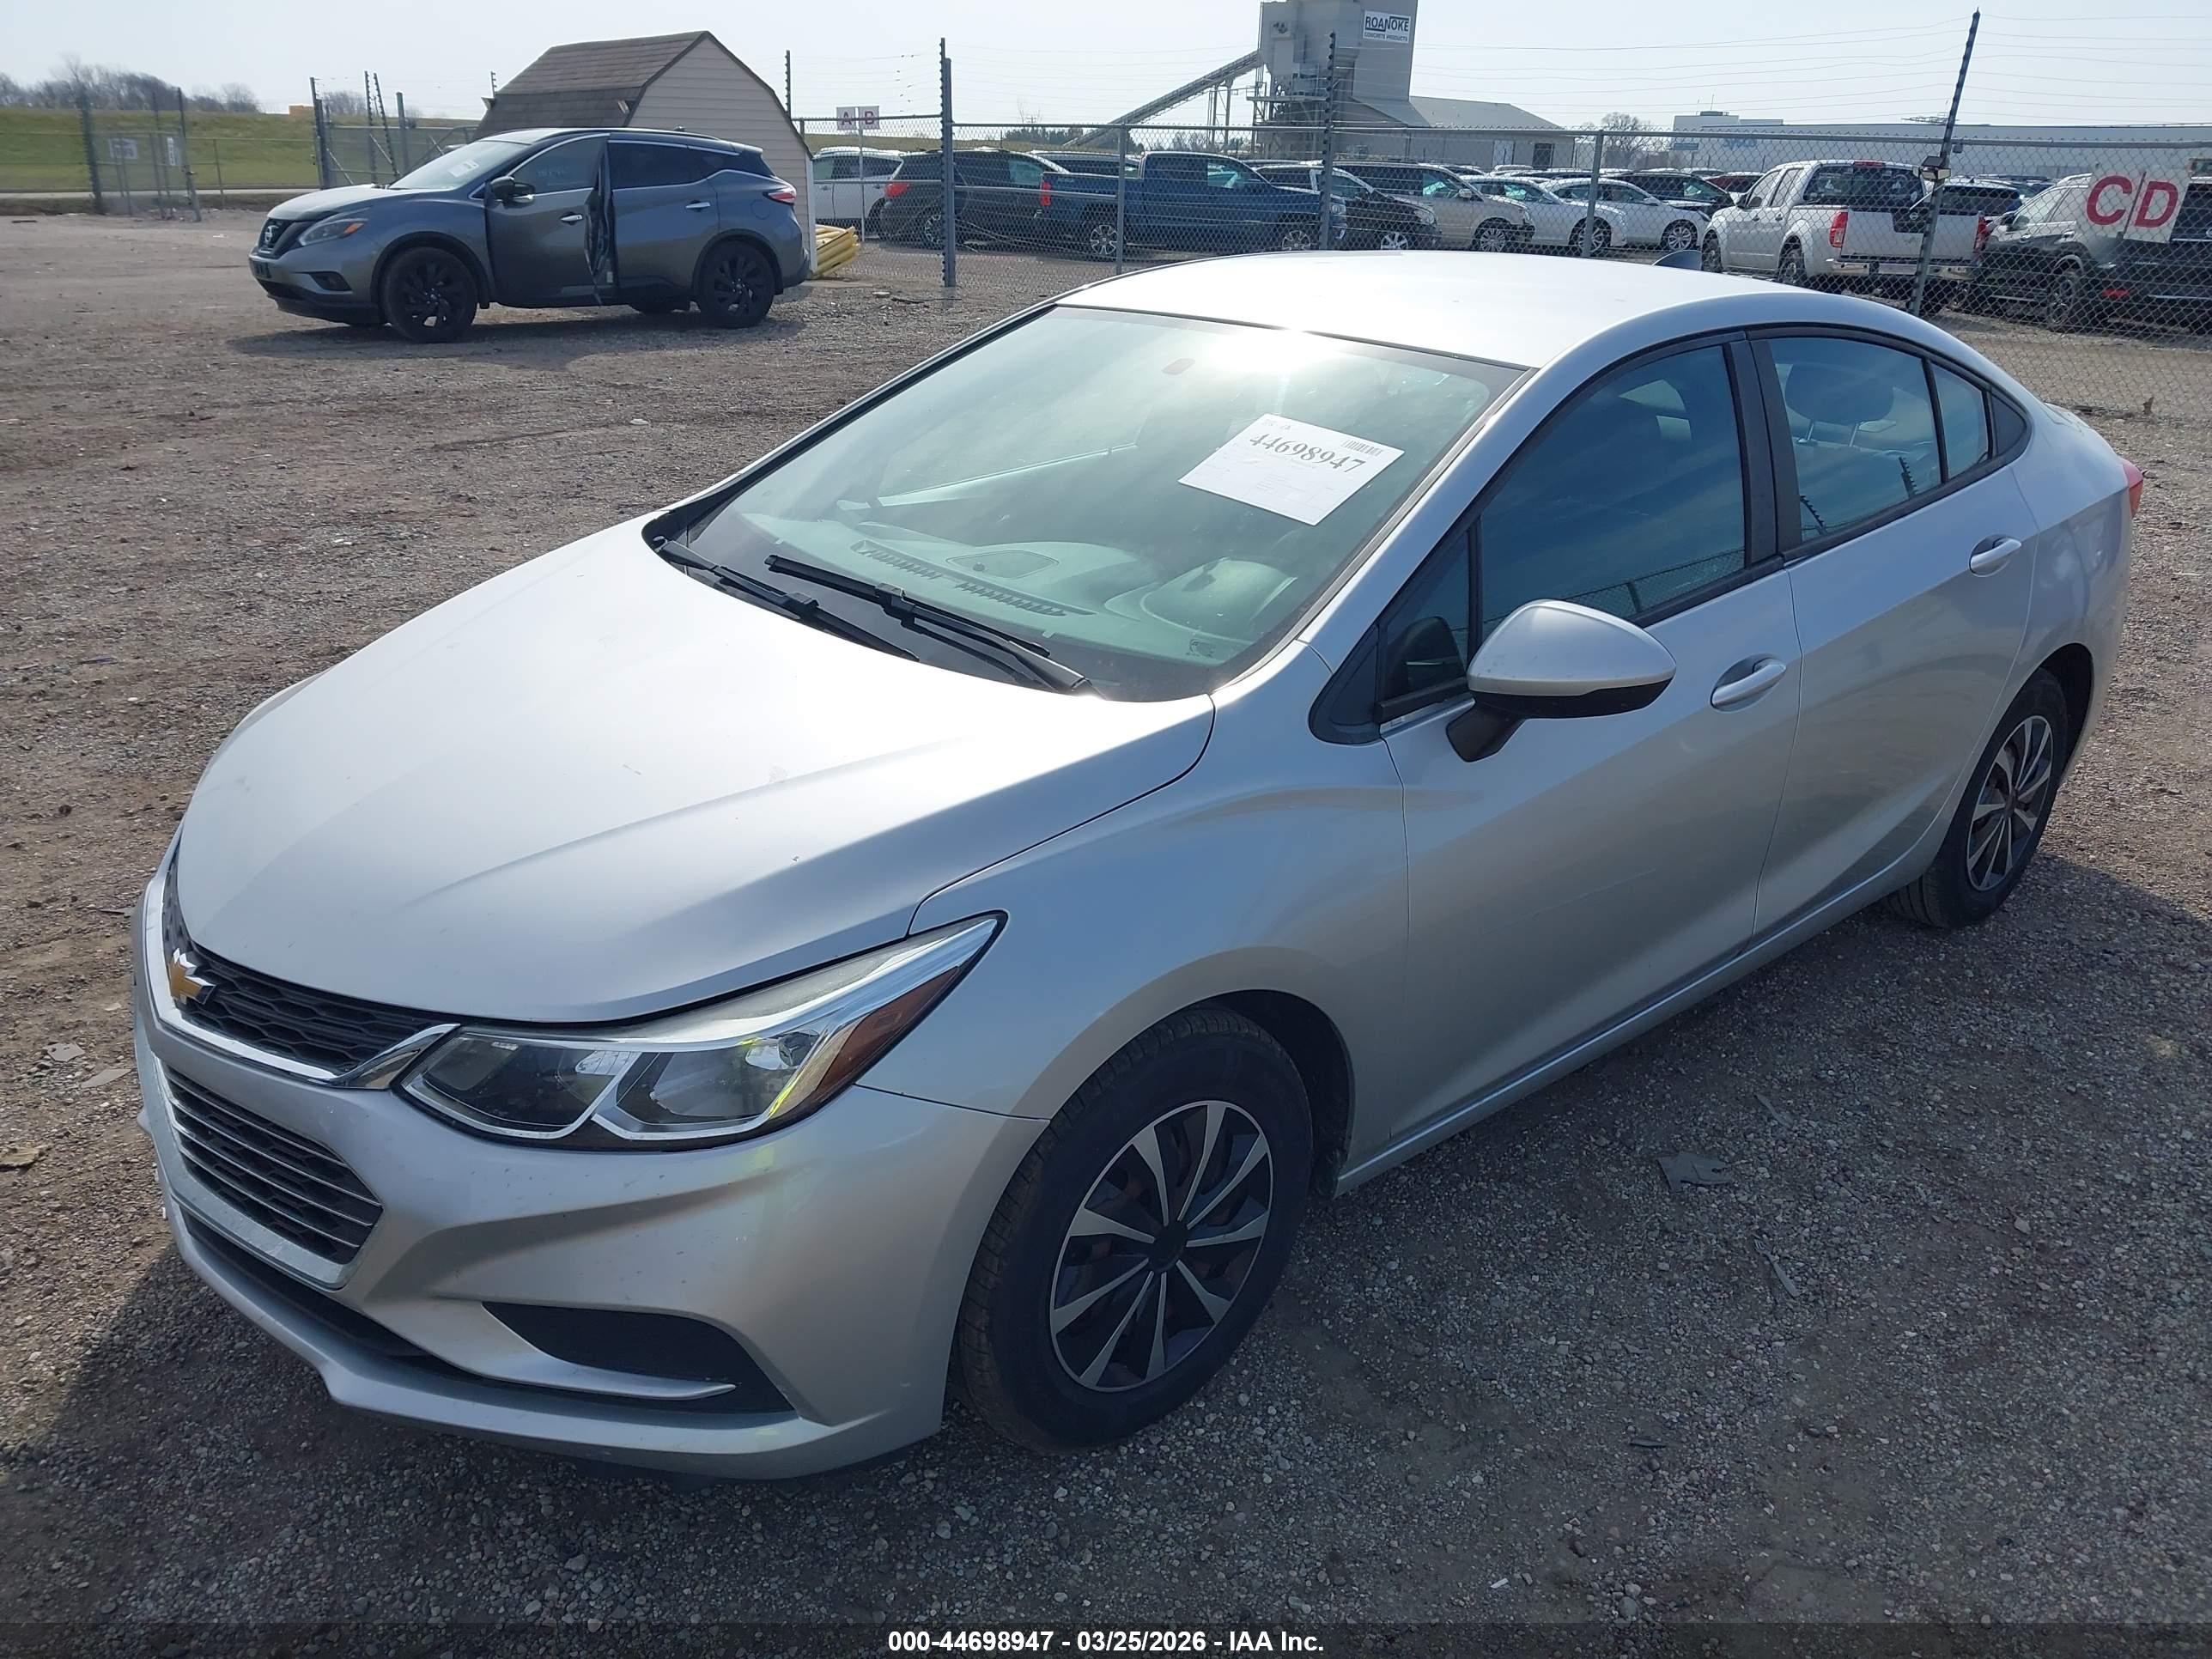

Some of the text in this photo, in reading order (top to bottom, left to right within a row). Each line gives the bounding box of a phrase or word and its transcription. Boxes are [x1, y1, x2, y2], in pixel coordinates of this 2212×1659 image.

[1365, 15, 1409, 32] ROANOKE
[842, 112, 852, 125] A
[864, 111, 874, 125] B
[2087, 175, 2133, 226] C
[2134, 180, 2179, 228] D
[1249, 433, 1366, 473] 44698947
